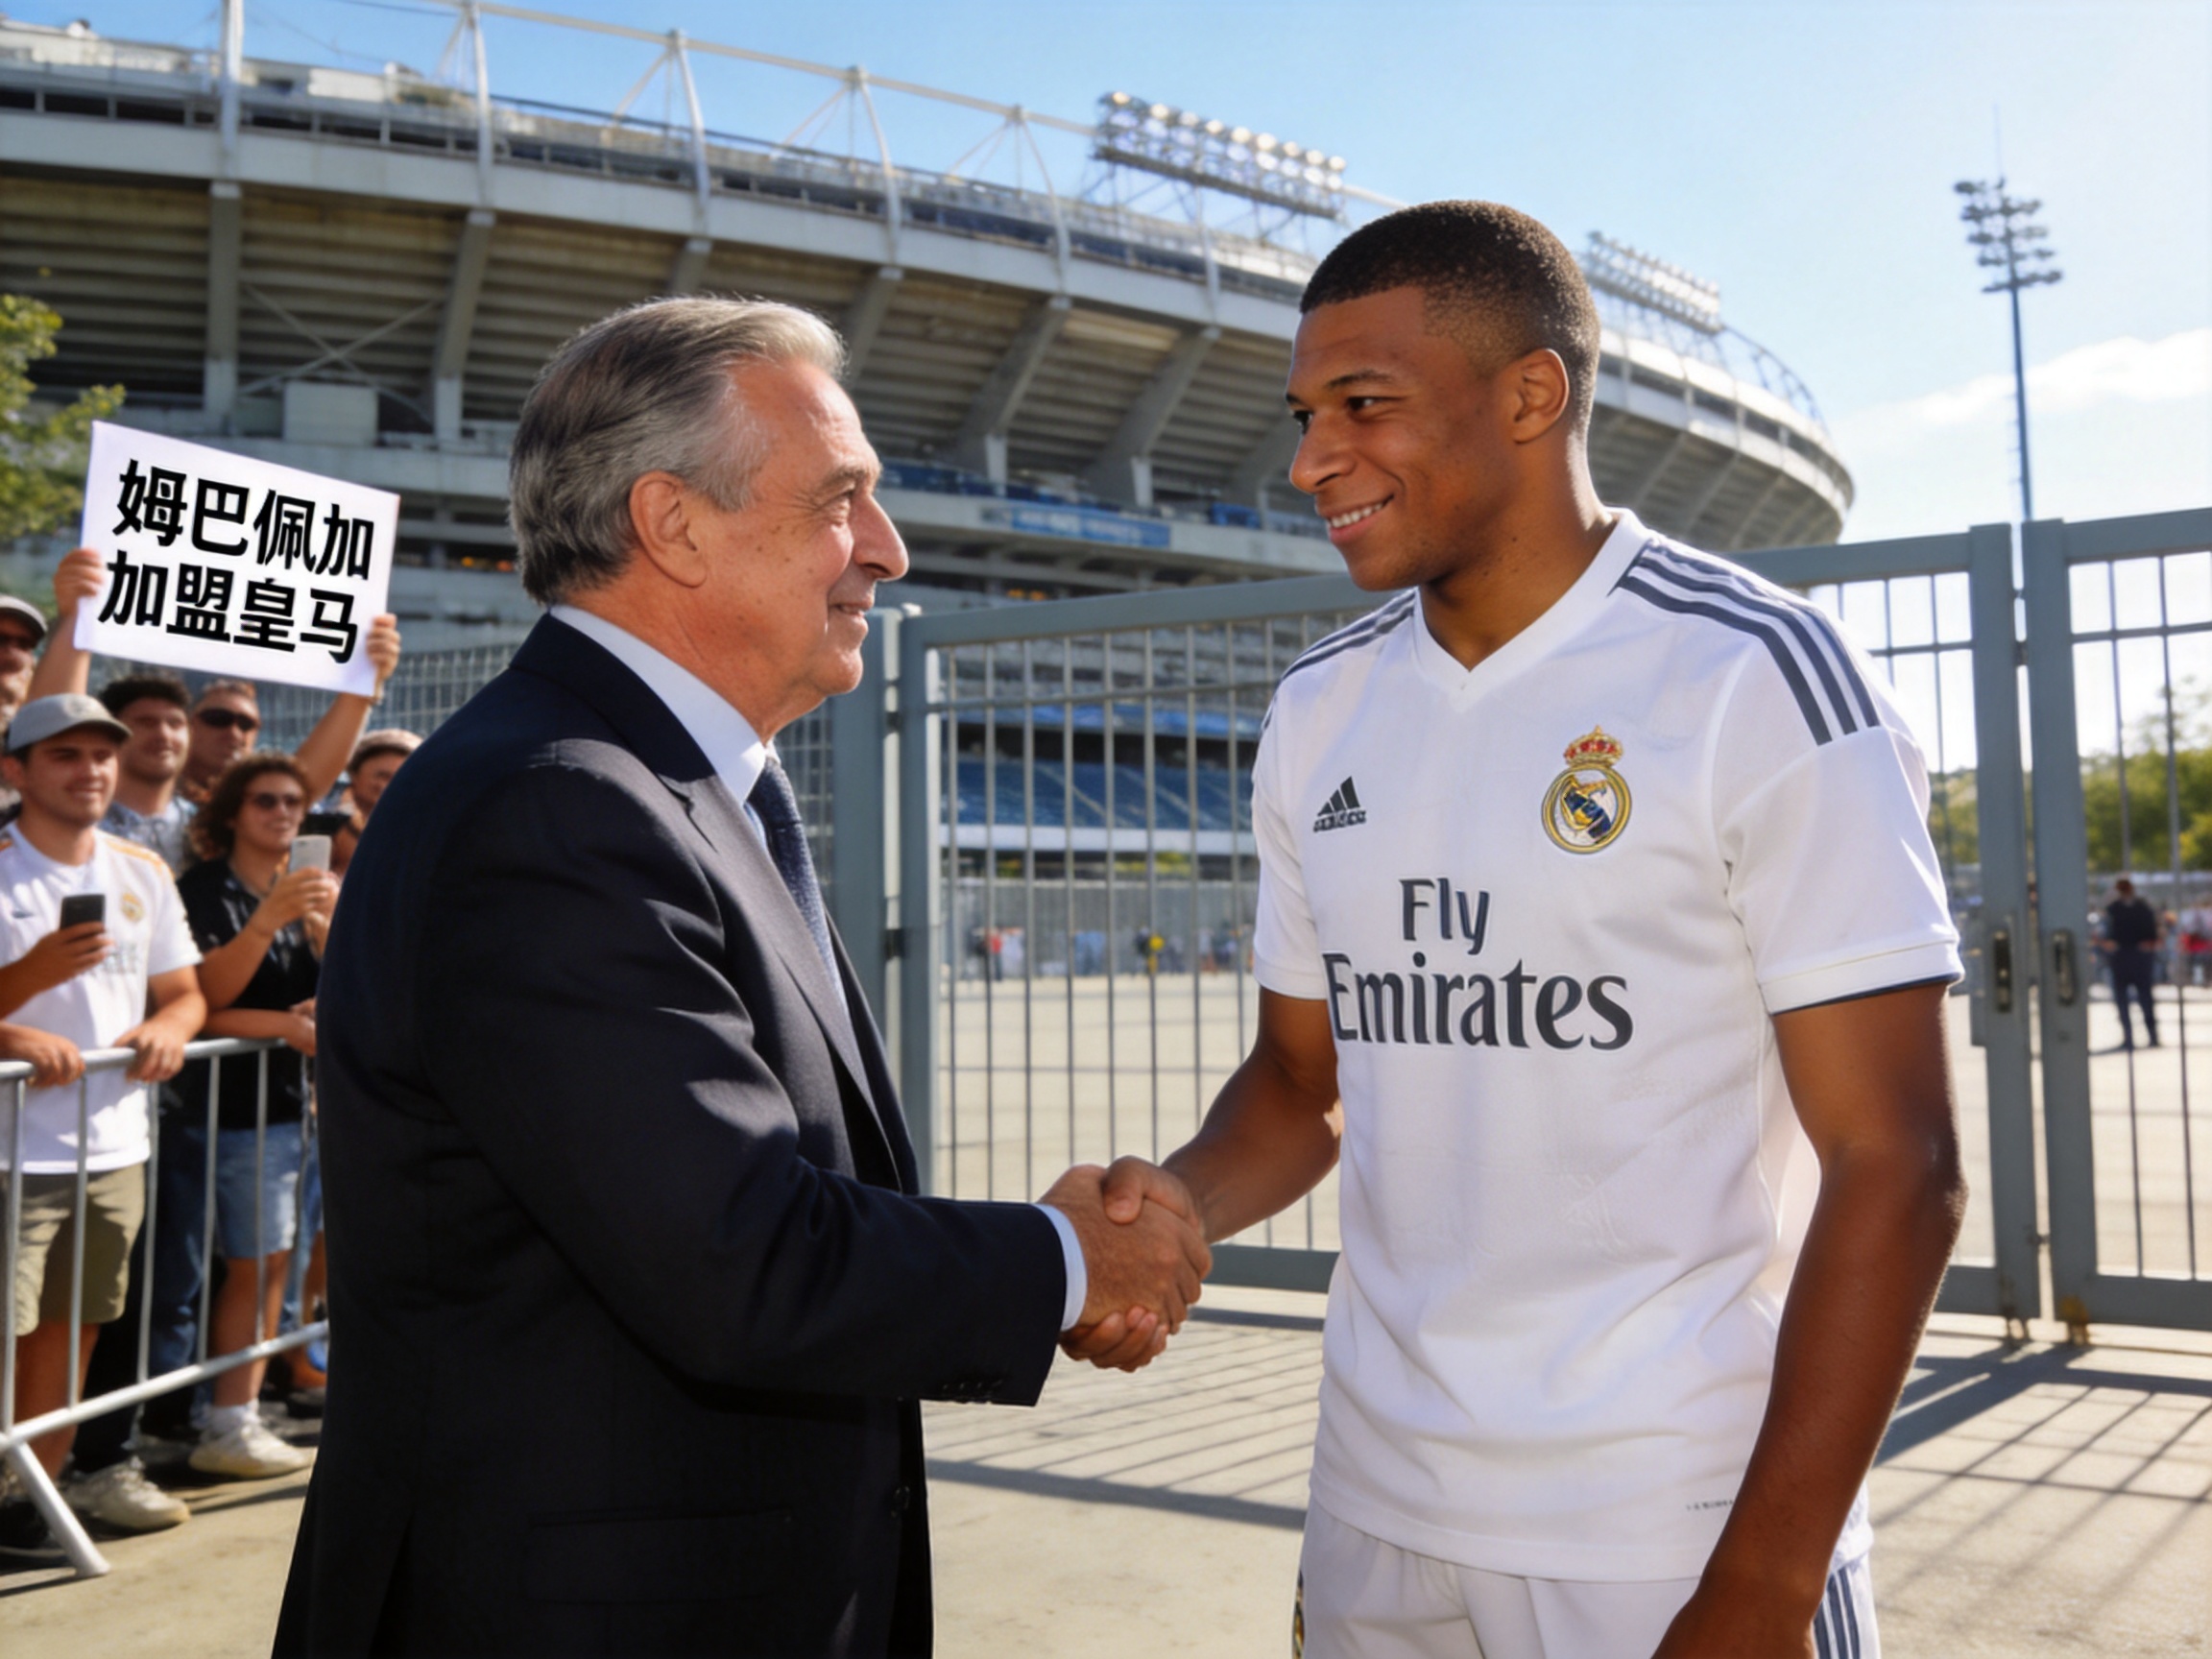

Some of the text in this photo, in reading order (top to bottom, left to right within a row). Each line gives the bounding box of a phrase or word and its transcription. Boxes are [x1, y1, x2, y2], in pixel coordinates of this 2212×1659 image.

[112, 459, 374, 580] 姆巴佩加
[98, 550, 358, 663] 加盟皇马
[1399, 878, 1490, 955] Fly
[1322, 951, 1633, 1050] Emirates
